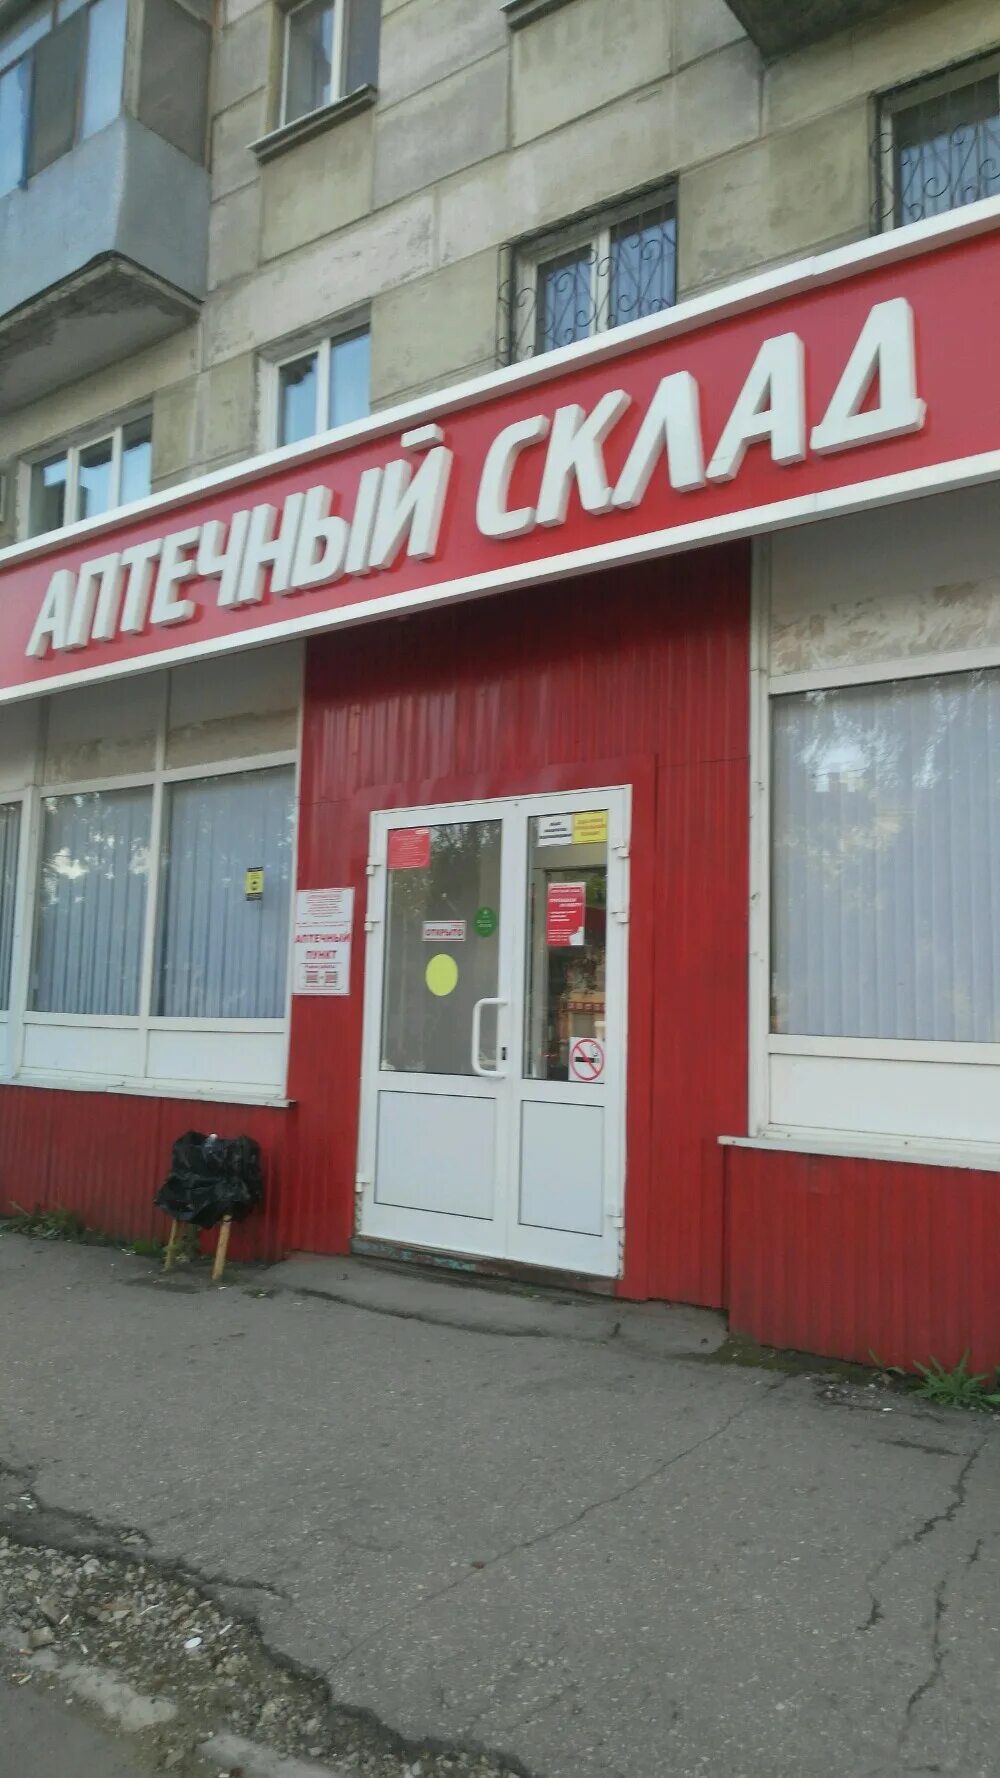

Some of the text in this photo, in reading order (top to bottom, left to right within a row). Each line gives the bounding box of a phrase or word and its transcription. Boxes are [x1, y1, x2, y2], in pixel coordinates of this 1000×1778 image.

[25, 297, 927, 659] АПТЕЧНЫЙ СКЛАД
[424, 928, 464, 936] ОТКРЫТО
[294, 933, 352, 943] АПТЕЧНЫЙ
[305, 950, 337, 959] ПУНКТ
